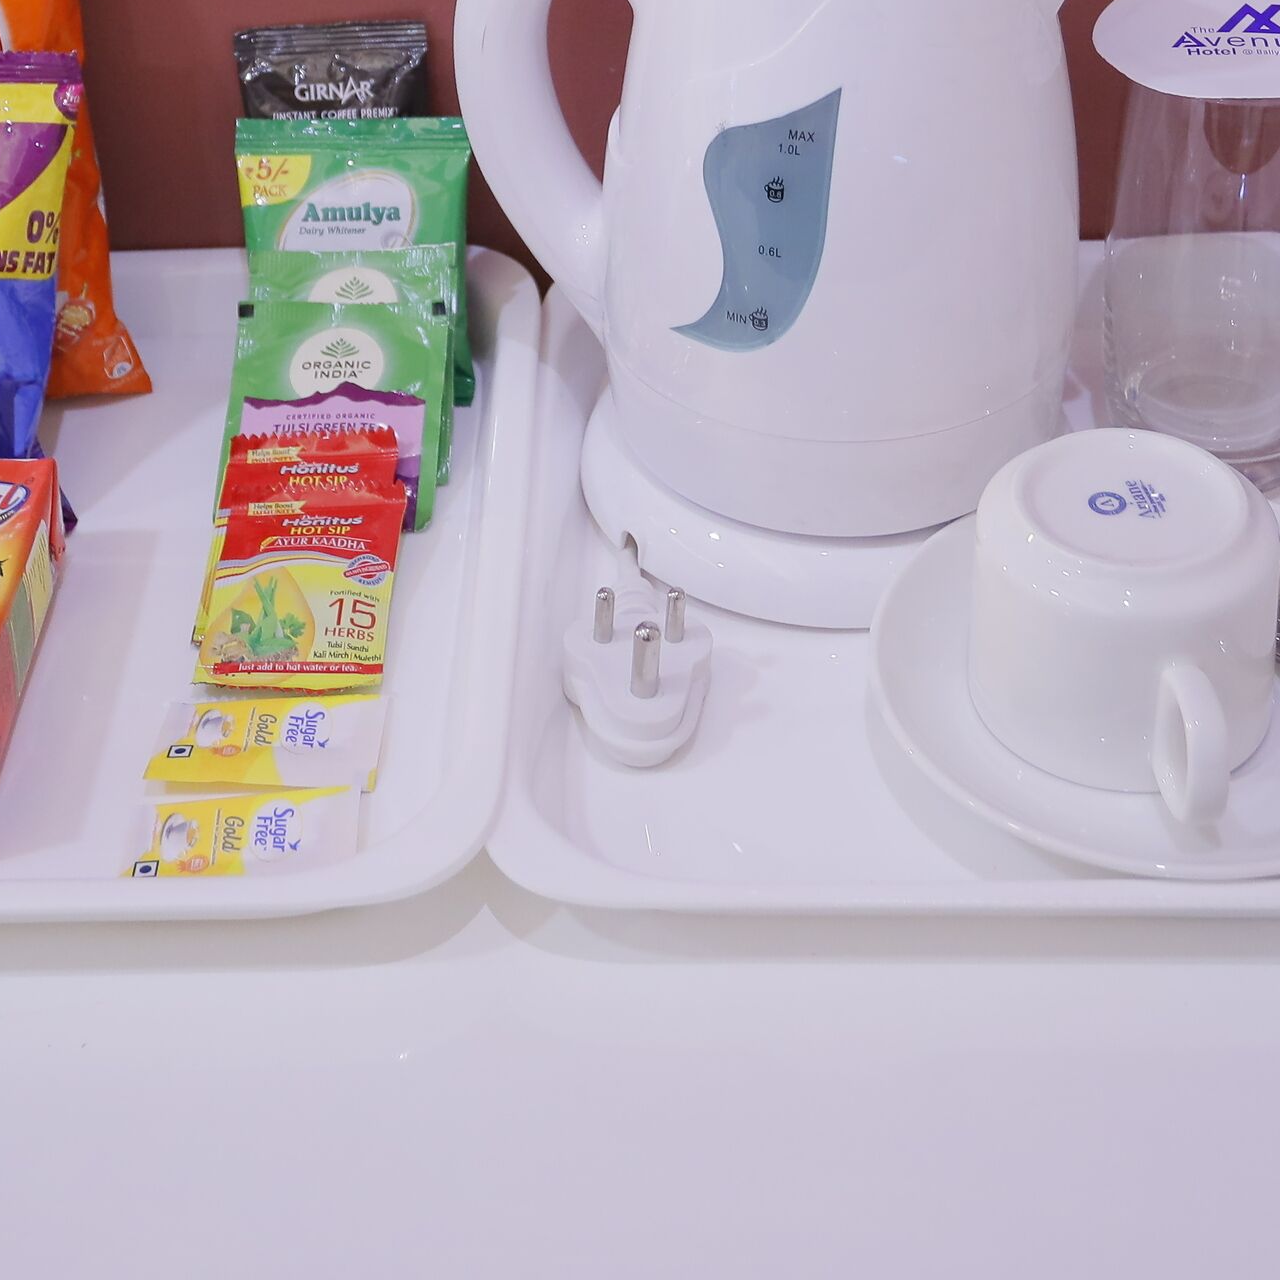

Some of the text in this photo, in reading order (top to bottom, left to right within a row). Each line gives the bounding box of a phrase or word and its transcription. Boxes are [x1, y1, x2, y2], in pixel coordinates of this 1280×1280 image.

[1190, 26, 1215, 34] The
[1187, 48, 1237, 56] Hotel
[293, 75, 375, 105] GIRNAR
[320, 109, 357, 120] COFFEE
[788, 129, 816, 143] MAX
[779, 143, 801, 156] 1.0L
[253, 183, 288, 198] PACK
[301, 202, 402, 226] Amulya
[25, 209, 60, 245] 0%
[298, 226, 367, 237] Dairy Whitener
[758, 244, 782, 258] 0.6L
[21, 251, 56, 275] FAT
[726, 310, 747, 325] MIN
[301, 360, 372, 370] ORGANIC
[314, 370, 358, 379] INDIA
[286, 412, 376, 421] CERTIFIED ORGANIC
[274, 422, 376, 434] TULSI GREEN TE
[280, 462, 360, 475] Honitus
[289, 475, 349, 488] HOT SIP
[282, 515, 364, 527] Honitus
[290, 525, 352, 536] HOT SIP
[274, 536, 367, 551] AYUR KAADHA
[329, 589, 381, 603] Fortified with
[328, 597, 377, 630] 15
[324, 626, 375, 643] HERBS
[327, 641, 369, 653] Tulsi Sunthi
[313, 650, 382, 662] Kali Mirch Mulethi
[238, 663, 358, 672] Just add to hot water or tea.
[254, 713, 278, 746] Gold
[286, 715, 306, 743] Free
[301, 709, 326, 749] Sugar
[221, 815, 245, 853] Gold
[255, 815, 273, 847] Free
[269, 807, 295, 853] Sugar
